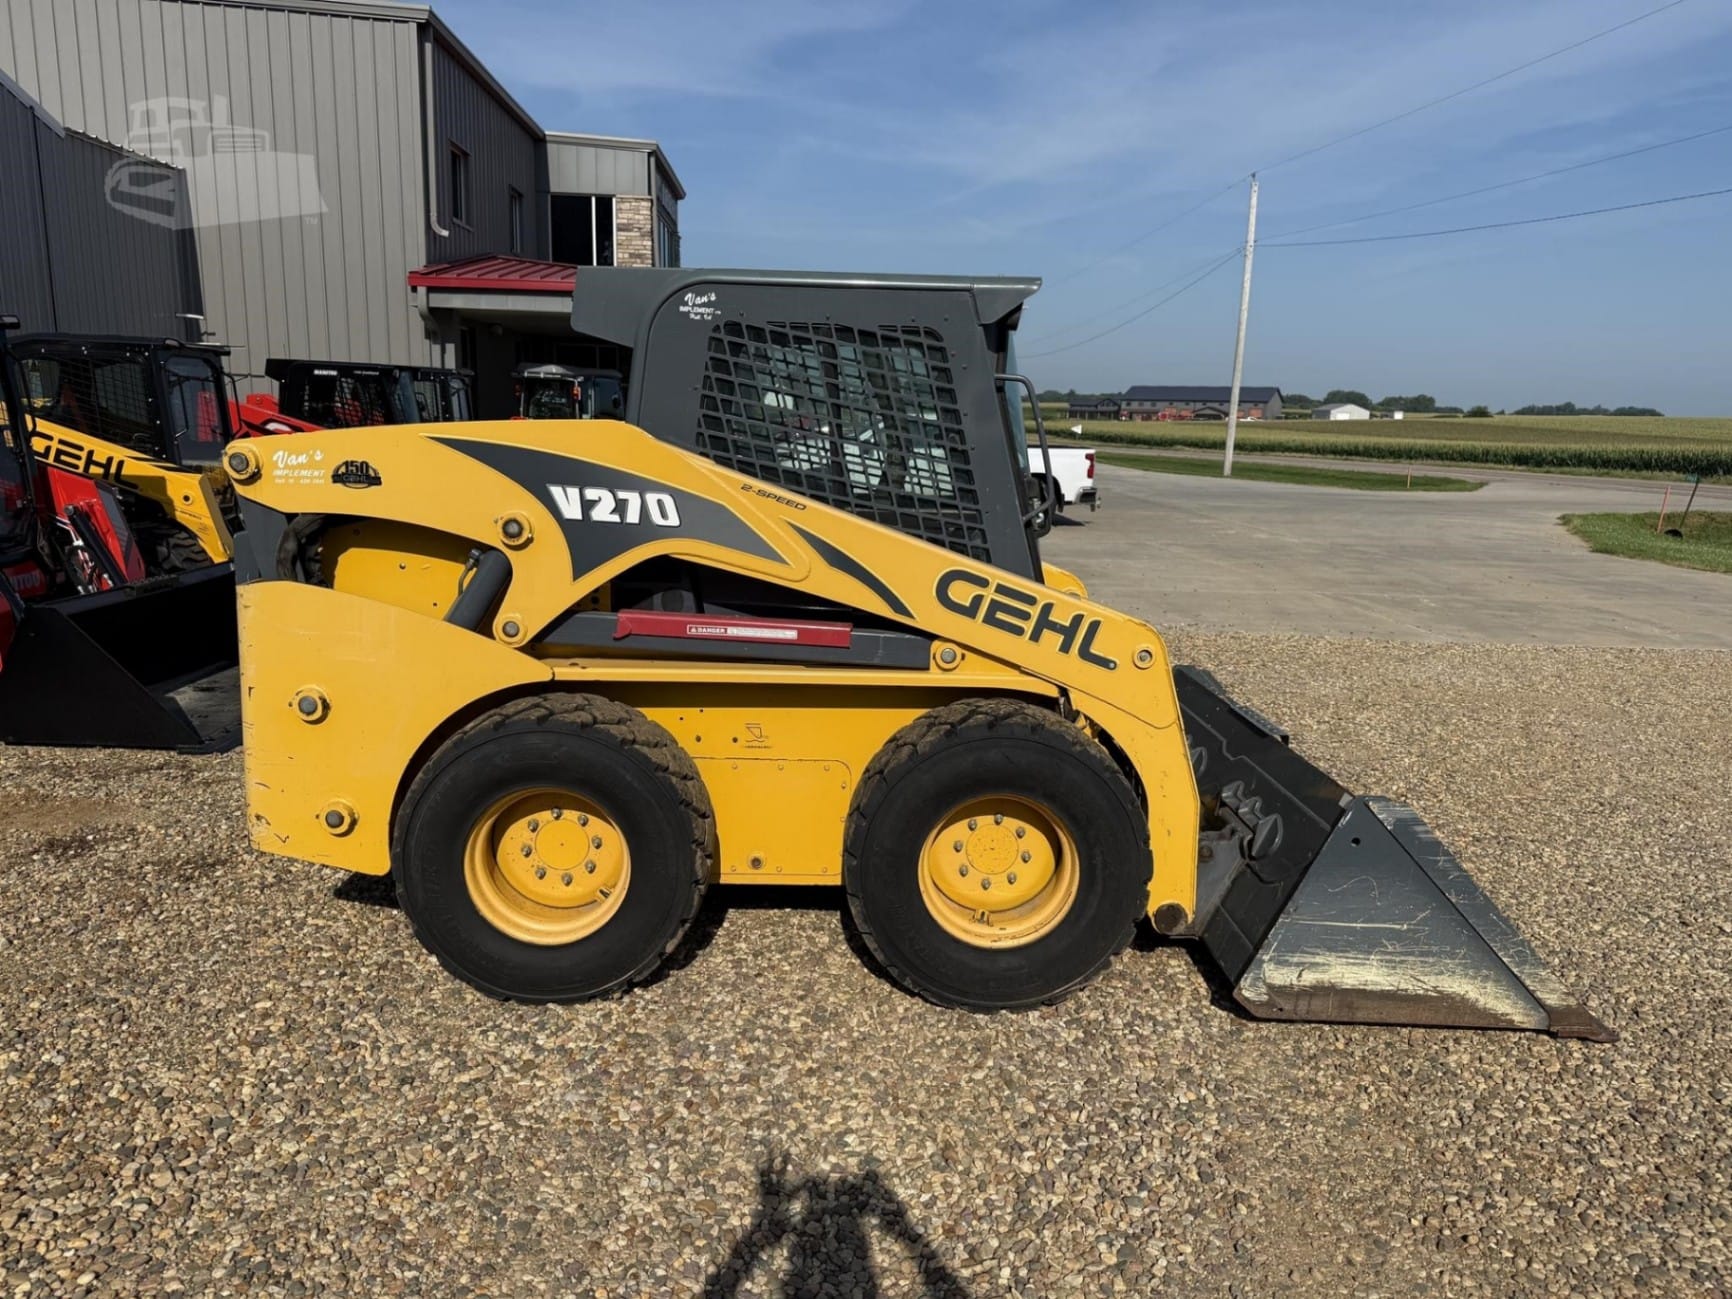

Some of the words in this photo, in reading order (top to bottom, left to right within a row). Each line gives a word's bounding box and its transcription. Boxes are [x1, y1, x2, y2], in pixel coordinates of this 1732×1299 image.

[684, 291, 717, 306] Van's
[30, 430, 139, 489] GEHL
[272, 449, 324, 468] Van's
[343, 460, 370, 475] 150
[272, 469, 326, 478] IMPLEMENT
[546, 483, 681, 527] V270
[740, 483, 808, 511] 2-SPEED
[935, 568, 1118, 671] GEHL
[697, 626, 726, 635] DANGER
